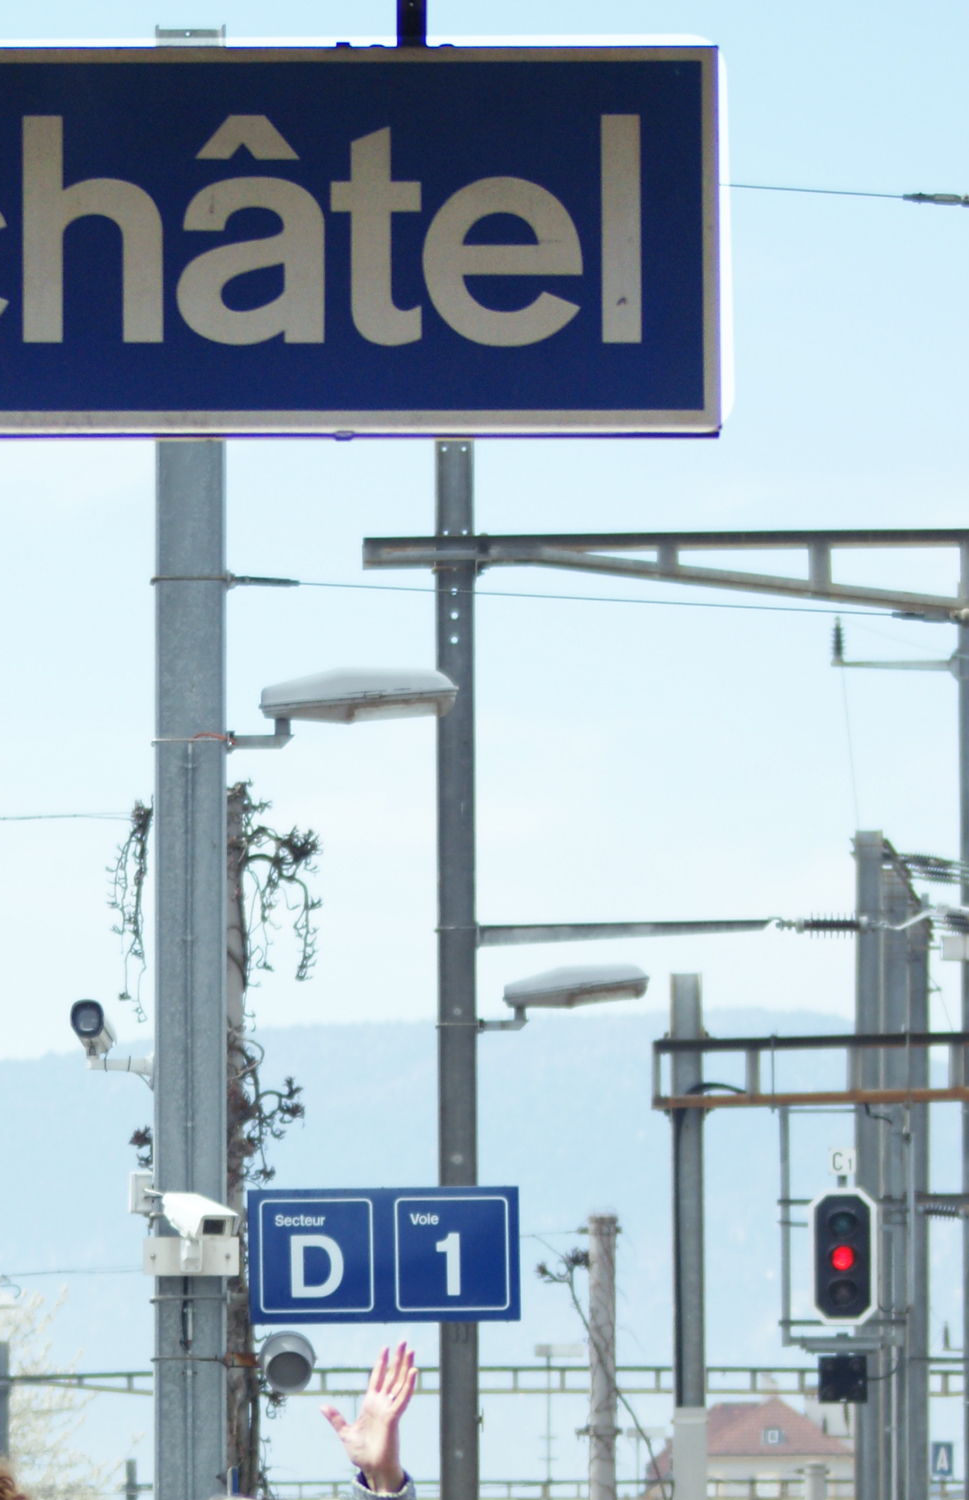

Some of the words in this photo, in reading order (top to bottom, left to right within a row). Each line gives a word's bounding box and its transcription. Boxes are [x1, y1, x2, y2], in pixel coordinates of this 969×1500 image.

[275, 1214, 326, 1227] Secteur
[410, 1213, 439, 1226] Voie
[290, 1234, 344, 1298] D
[435, 1232, 461, 1296] 1
[936, 1446, 949, 1471] A
